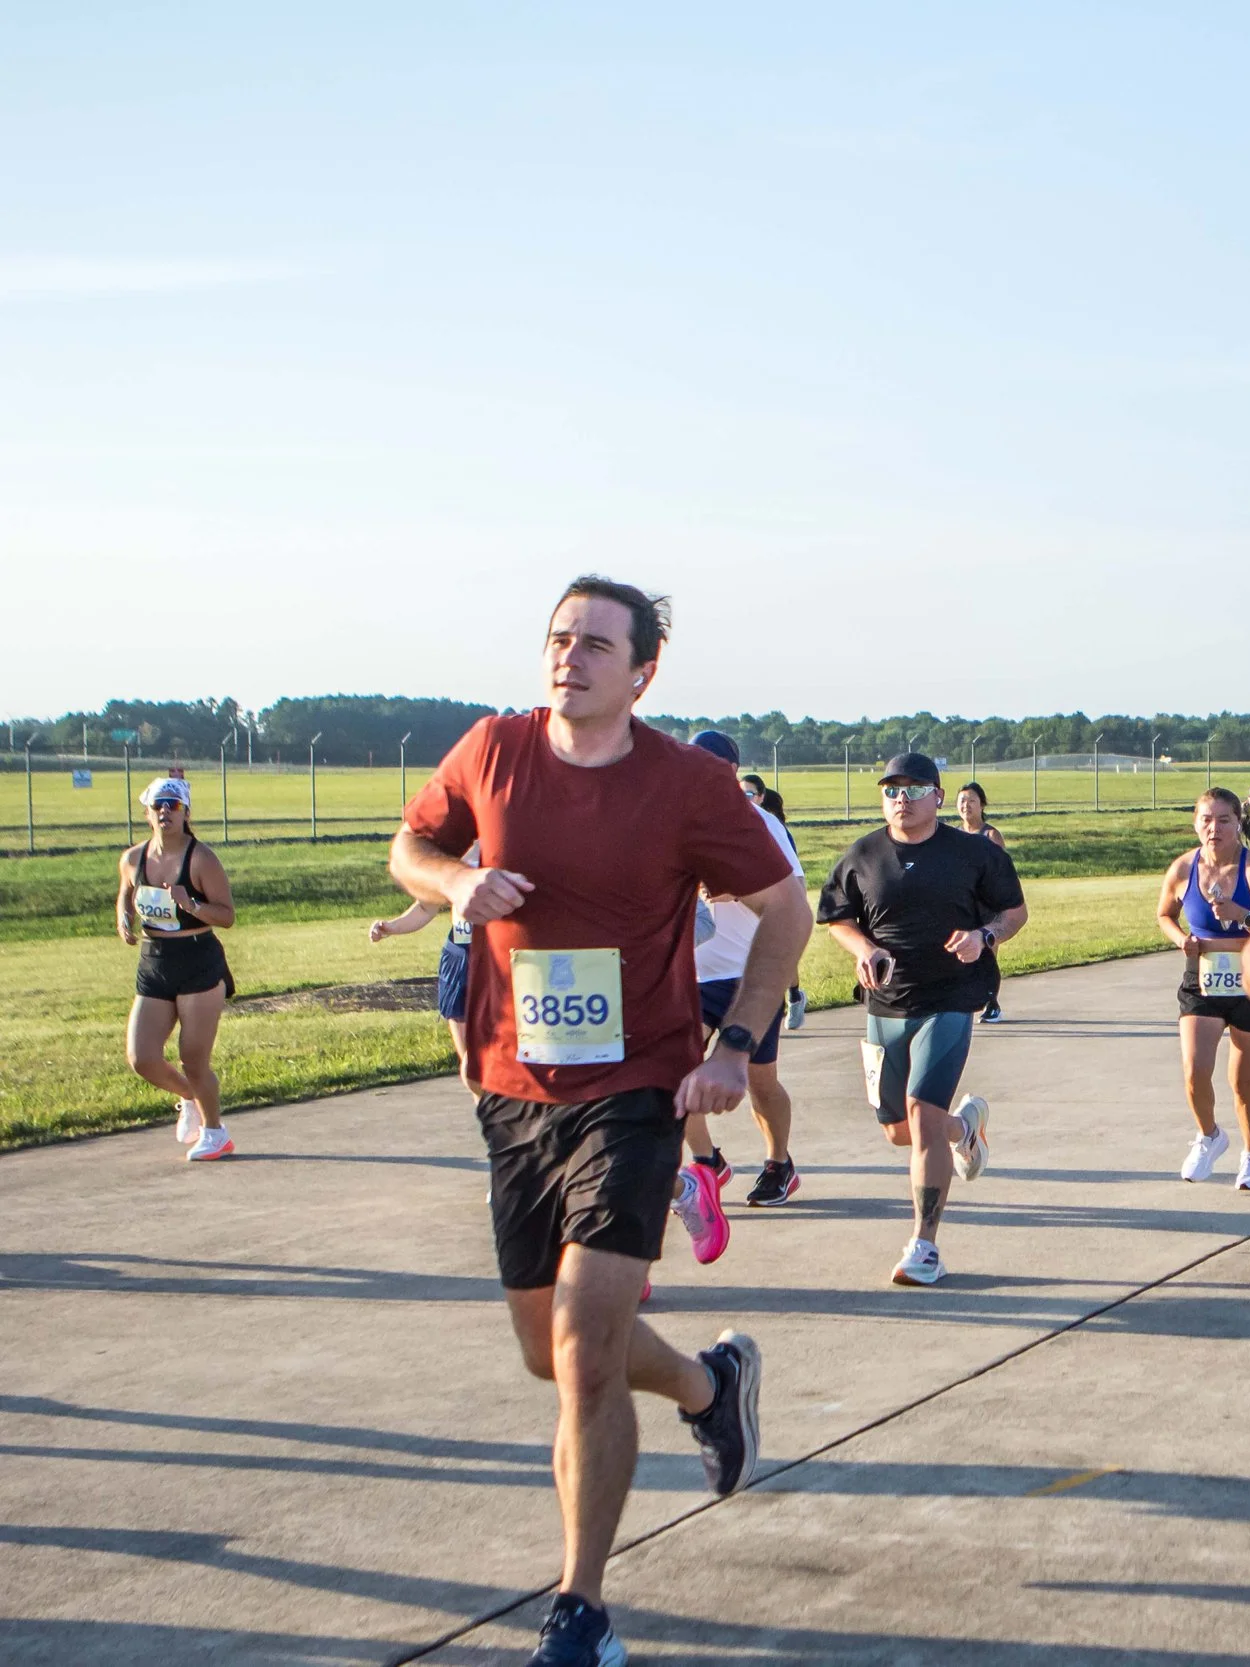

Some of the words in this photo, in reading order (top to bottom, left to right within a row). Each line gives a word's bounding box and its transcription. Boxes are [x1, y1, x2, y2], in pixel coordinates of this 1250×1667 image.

[137, 903, 172, 919] 3205
[1203, 972, 1243, 988] 3785
[522, 993, 609, 1026] 3859
